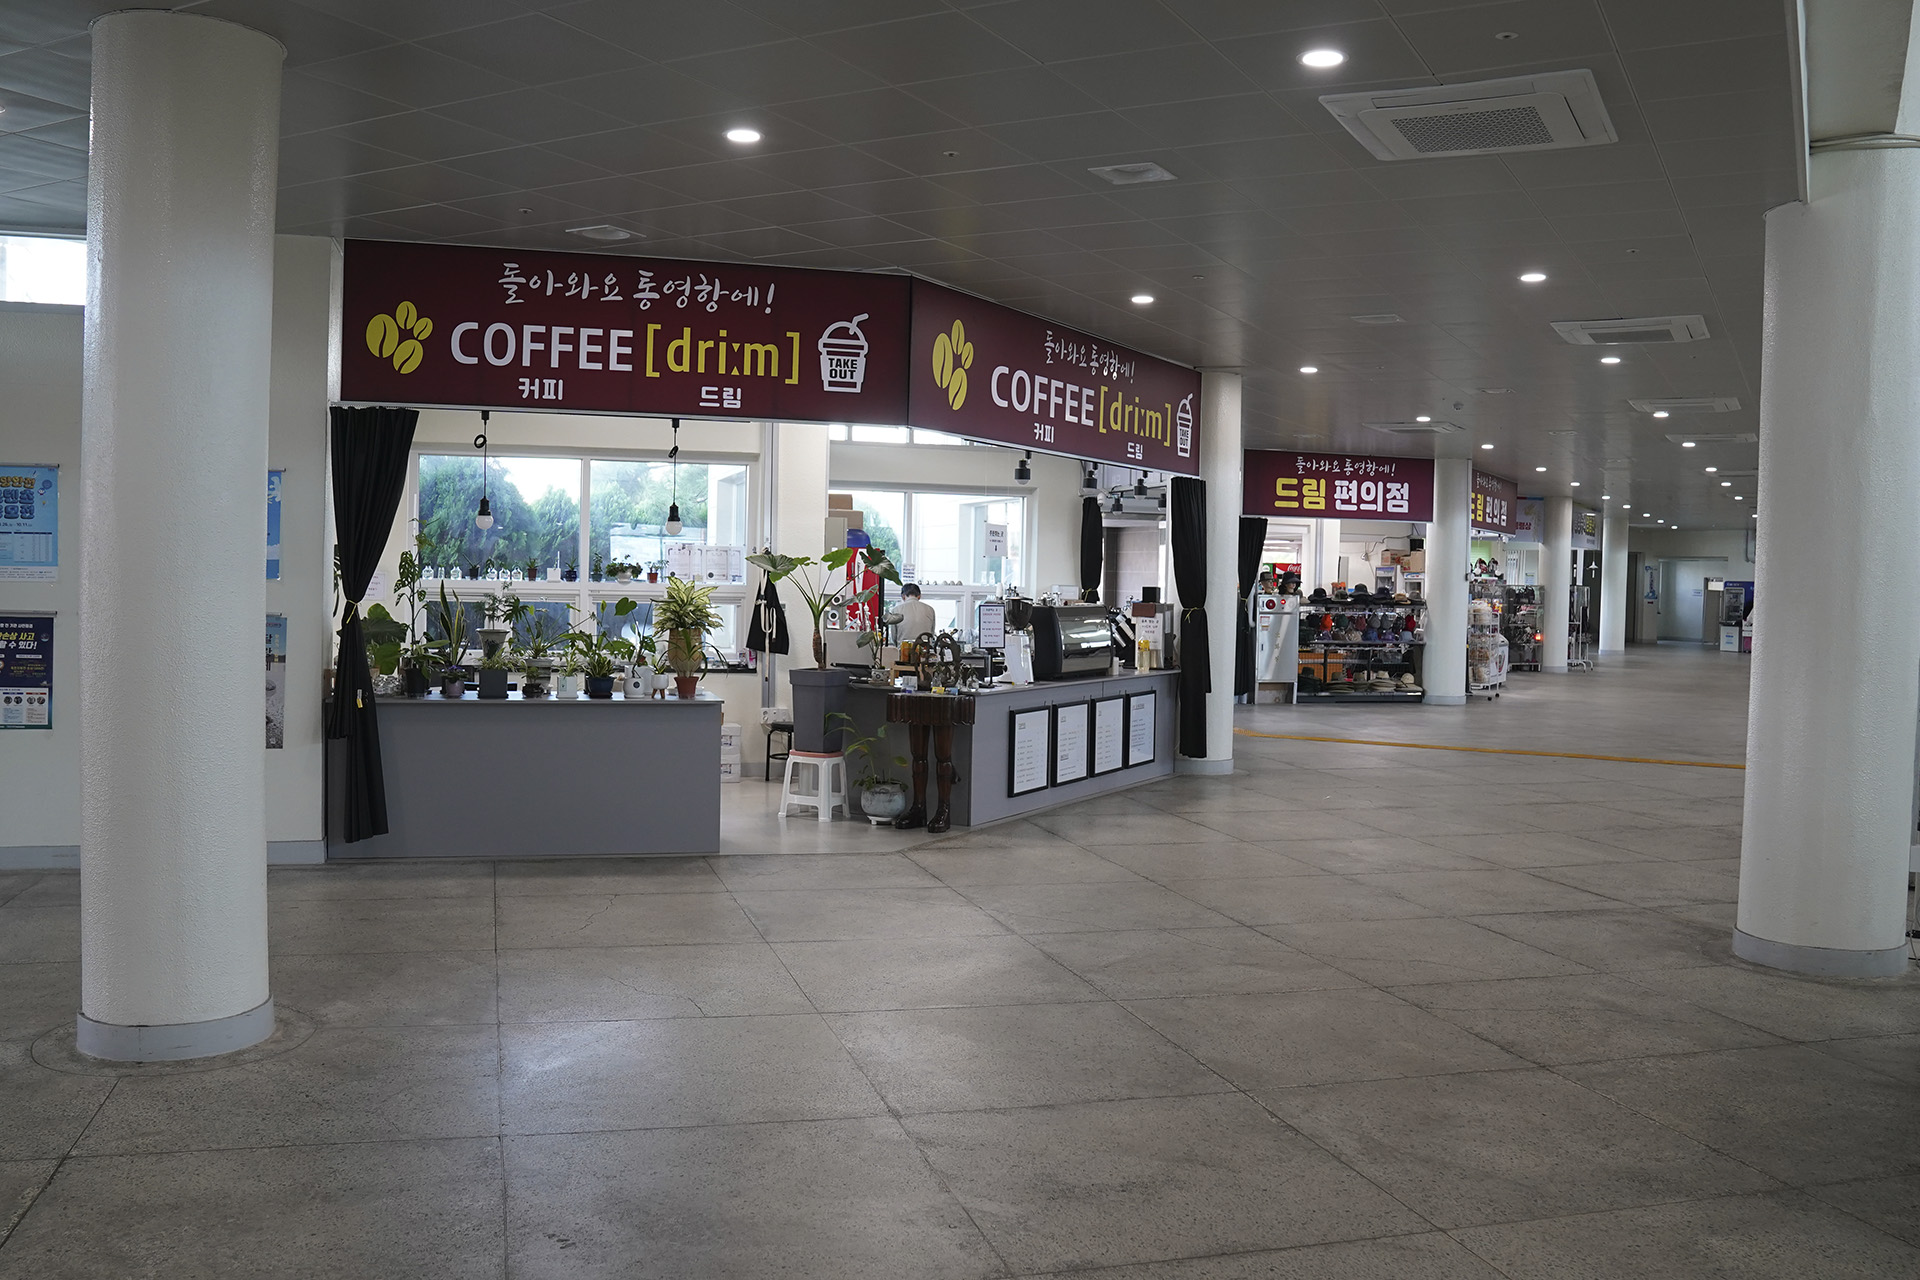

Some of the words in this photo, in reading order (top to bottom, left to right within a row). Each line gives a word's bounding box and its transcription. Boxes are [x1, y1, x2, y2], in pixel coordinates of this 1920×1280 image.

[498, 262, 623, 304] 돌아와요
[633, 269, 775, 314] 통영항에!
[451, 321, 633, 372] COFFEE
[1044, 330, 1087, 365] 돌아와요
[1086, 344, 1135, 384] 통영항에!
[828, 357, 858, 369] TAKE
[829, 368, 857, 380] OUT
[518, 377, 565, 401] 커피
[699, 386, 742, 409] 드림
[990, 365, 1095, 427] COFFEE
[1033, 422, 1055, 444] 커피
[1127, 441, 1143, 460] 드림
[1179, 428, 1189, 439] TAKE
[1179, 437, 1189, 447] OUT
[1295, 456, 1341, 474] 돌아와요
[1343, 458, 1396, 477] 통영항에!
[0, 489, 35, 504] 텐츠
[1274, 477, 1326, 510] 드림
[1333, 480, 1409, 513] 편의점
[0, 504, 35, 519] 모전
[1486, 495, 1508, 527] 편의점
[9, 640, 17, 649] 수
[18, 640, 38, 650] 있다!
[19, 632, 35, 641] 사고
